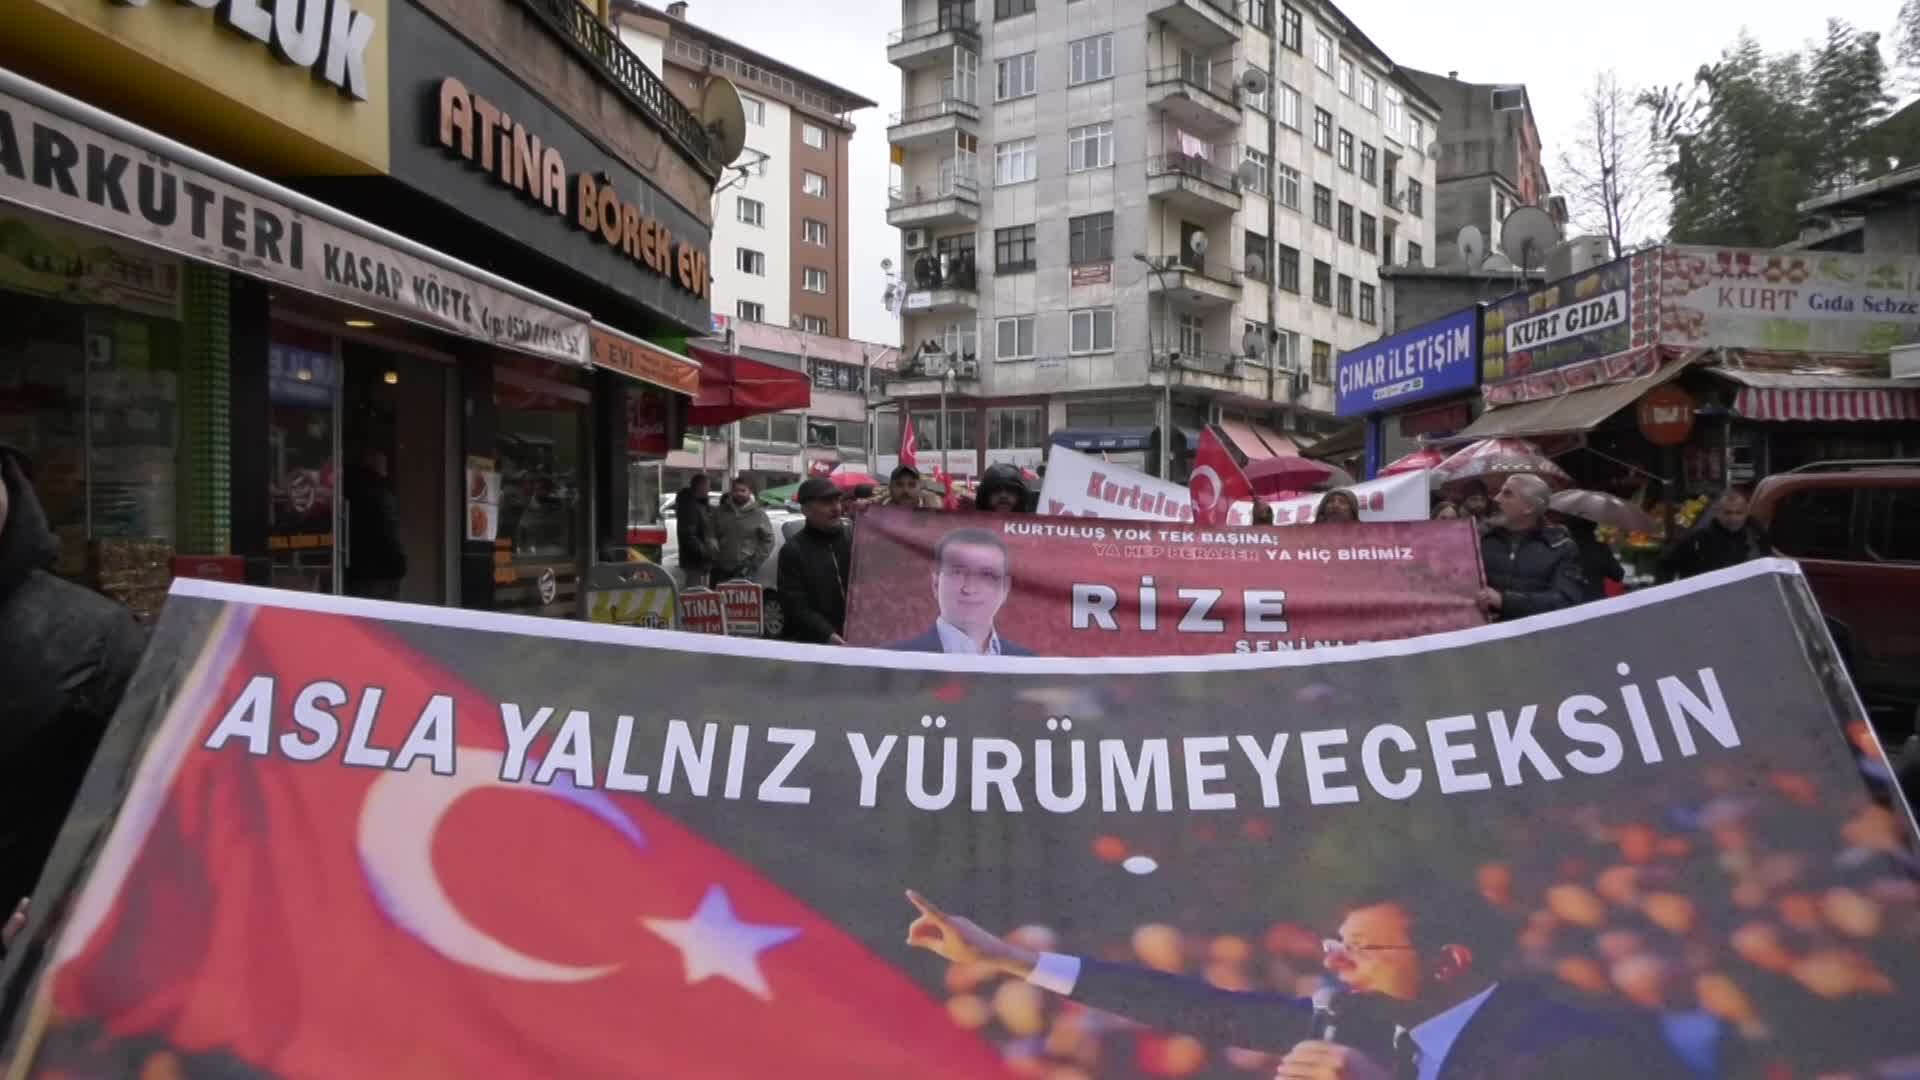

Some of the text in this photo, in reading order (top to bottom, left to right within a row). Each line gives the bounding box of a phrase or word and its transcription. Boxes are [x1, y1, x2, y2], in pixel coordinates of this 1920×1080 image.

[323, 243, 403, 300] KASAP
[1511, 296, 1619, 348] KURT GIDA
[1718, 287, 1798, 312] KURT
[1340, 354, 1385, 398] ÇINAR
[1388, 324, 1470, 381] İLETİŞİM
[1003, 522, 1105, 541] KURTULUŞ
[1112, 528, 1152, 541] YOK
[1158, 530, 1194, 542] TEK
[1265, 548, 1292, 560] YA
[1298, 546, 1332, 564] HİÇ
[1338, 545, 1414, 561] BİRİMİZ
[1071, 575, 1289, 633] RİZE
[204, 661, 1742, 813] ASLA YALNIZ YÜRÜMEYECEKSİN
